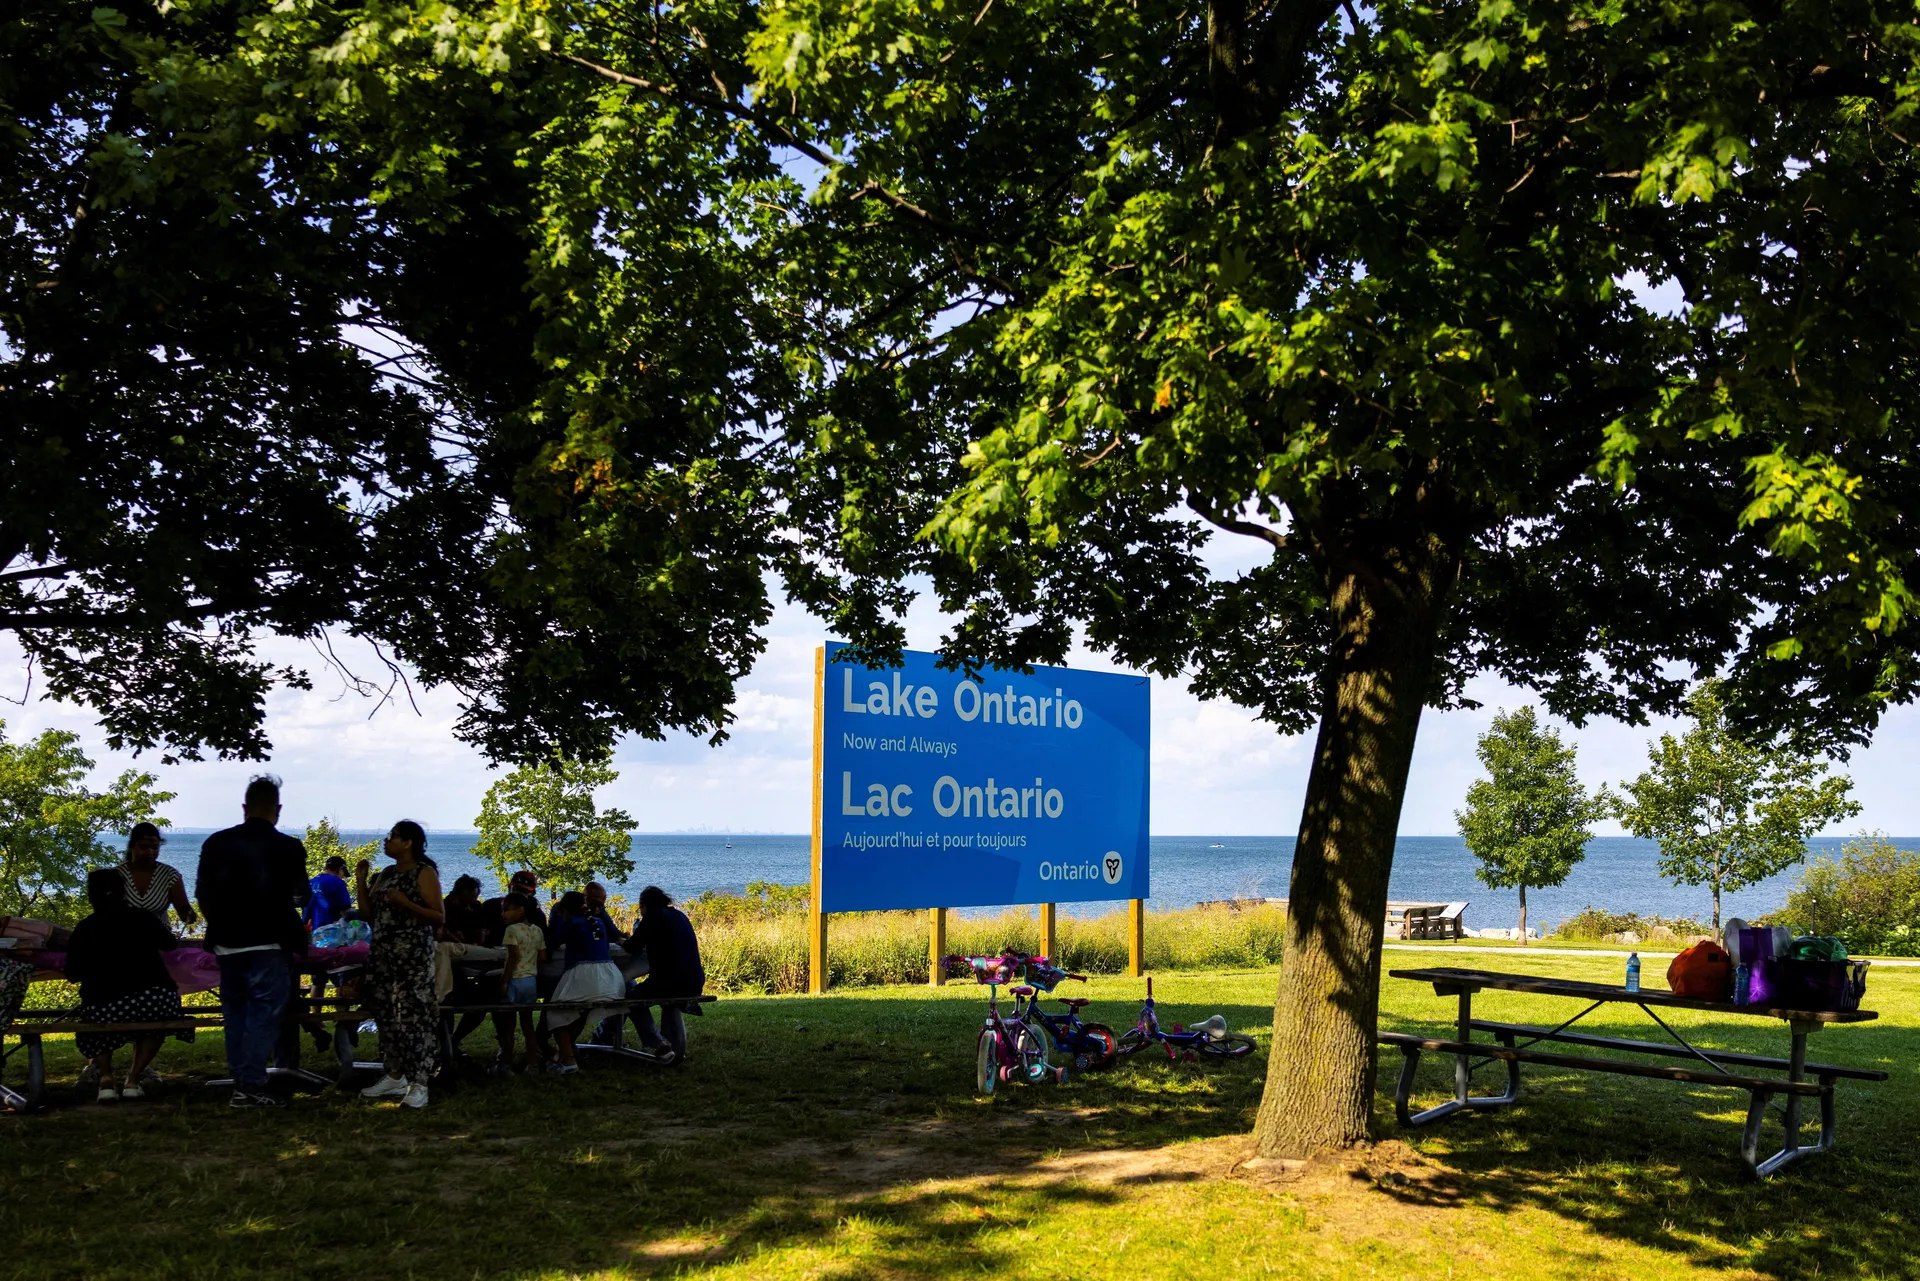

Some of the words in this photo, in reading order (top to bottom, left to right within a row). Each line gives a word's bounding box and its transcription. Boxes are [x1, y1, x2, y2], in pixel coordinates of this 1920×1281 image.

[844, 668, 938, 718] Lake
[954, 680, 1083, 729] Ontario
[843, 733, 876, 750] Now
[880, 736, 905, 751] and
[909, 737, 957, 758] Always
[843, 772, 912, 816] Lac
[933, 776, 1063, 818] Ontario
[843, 832, 922, 851] Aujourd'hui
[927, 833, 939, 847] et
[944, 835, 974, 851] pour
[977, 832, 1026, 850] toujours
[1040, 861, 1098, 880] Ontario
